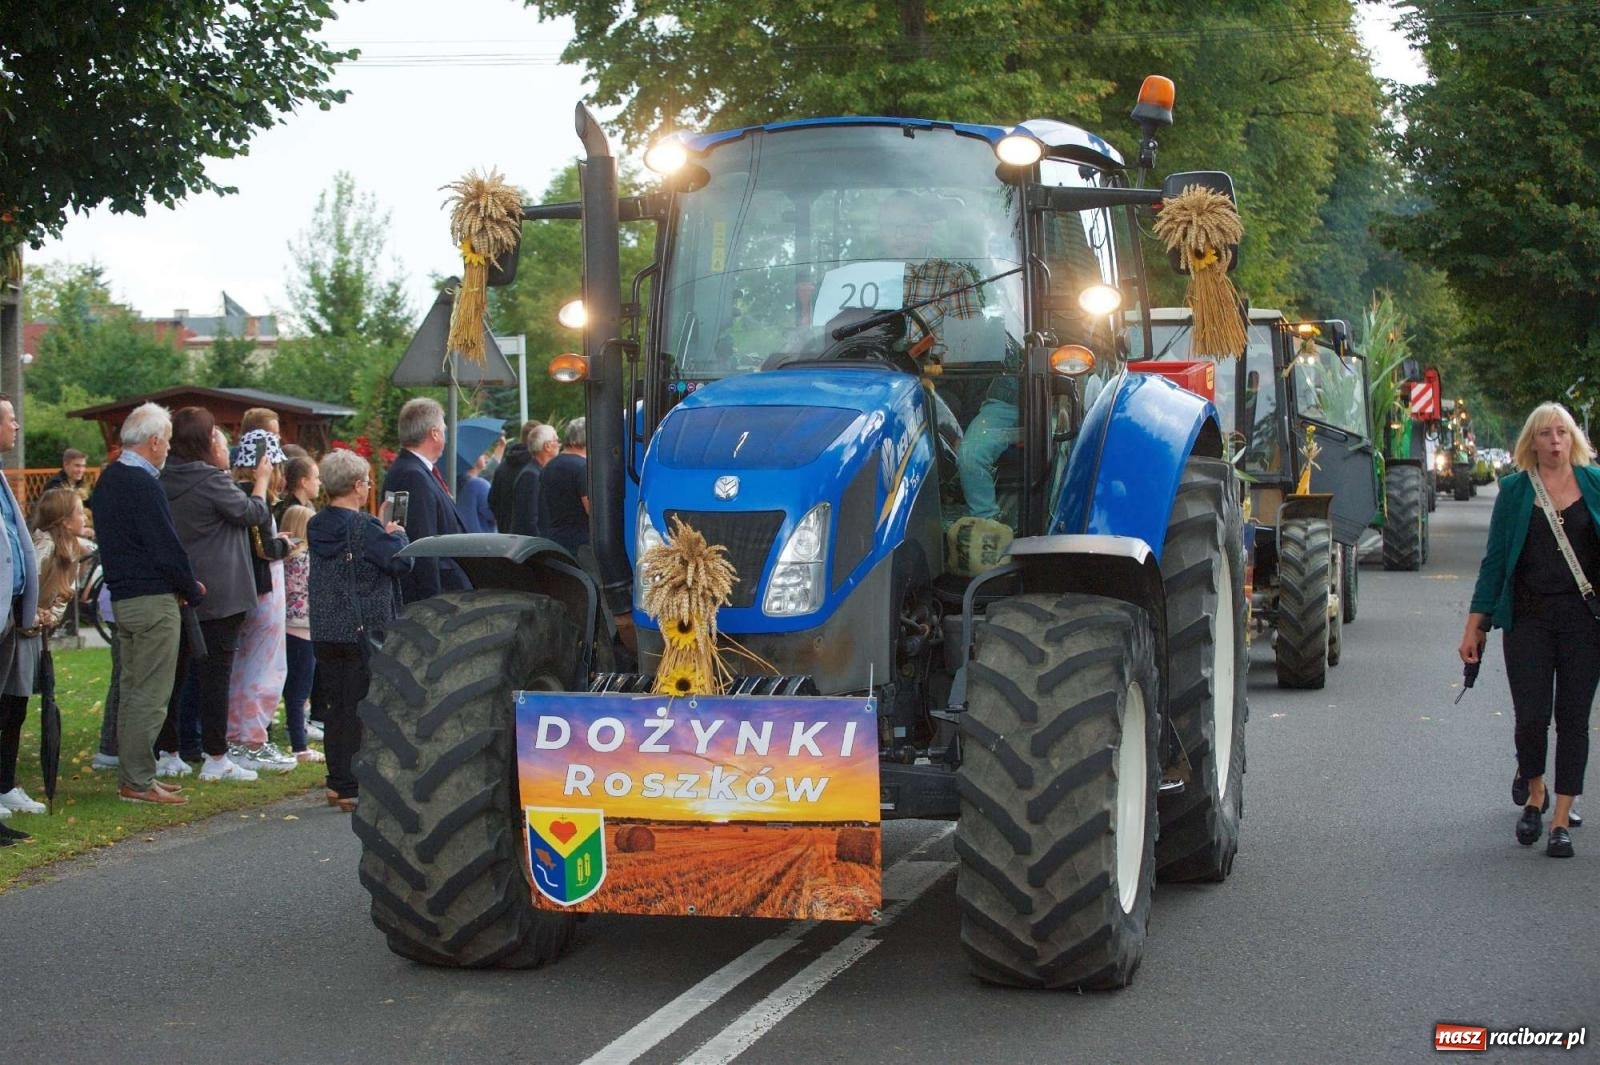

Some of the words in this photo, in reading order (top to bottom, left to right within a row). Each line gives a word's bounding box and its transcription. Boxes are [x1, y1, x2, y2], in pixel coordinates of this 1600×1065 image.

[839, 282, 879, 310] 20
[535, 706, 857, 757] DOŻYNKI
[563, 763, 831, 802] Roszków
